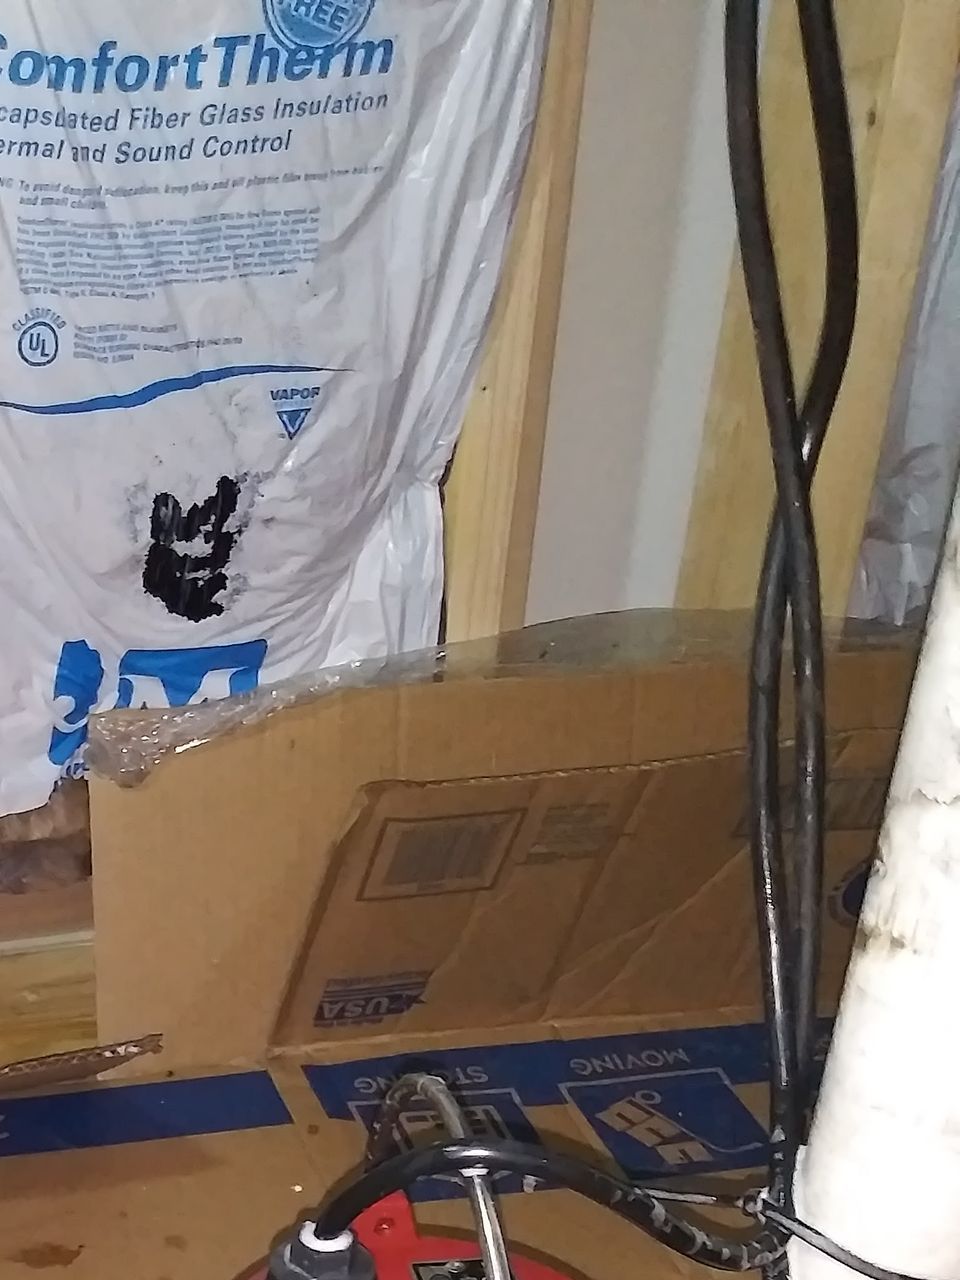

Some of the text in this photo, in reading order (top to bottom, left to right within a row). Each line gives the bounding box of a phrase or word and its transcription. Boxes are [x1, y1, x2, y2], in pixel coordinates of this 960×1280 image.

[292, 0, 350, 32] REE
[129, 106, 190, 130] Fiber
[200, 103, 264, 126] Glass
[273, 92, 388, 120] Insulation
[115, 138, 194, 164] Sound
[203, 129, 292, 158] Control
[12, 307, 68, 332] CLASSIFIED
[29, 332, 50, 358] UL
[321, 996, 390, 1019] USA
[570, 1046, 693, 1077] MOVING
[353, 1065, 489, 1094] STNG
